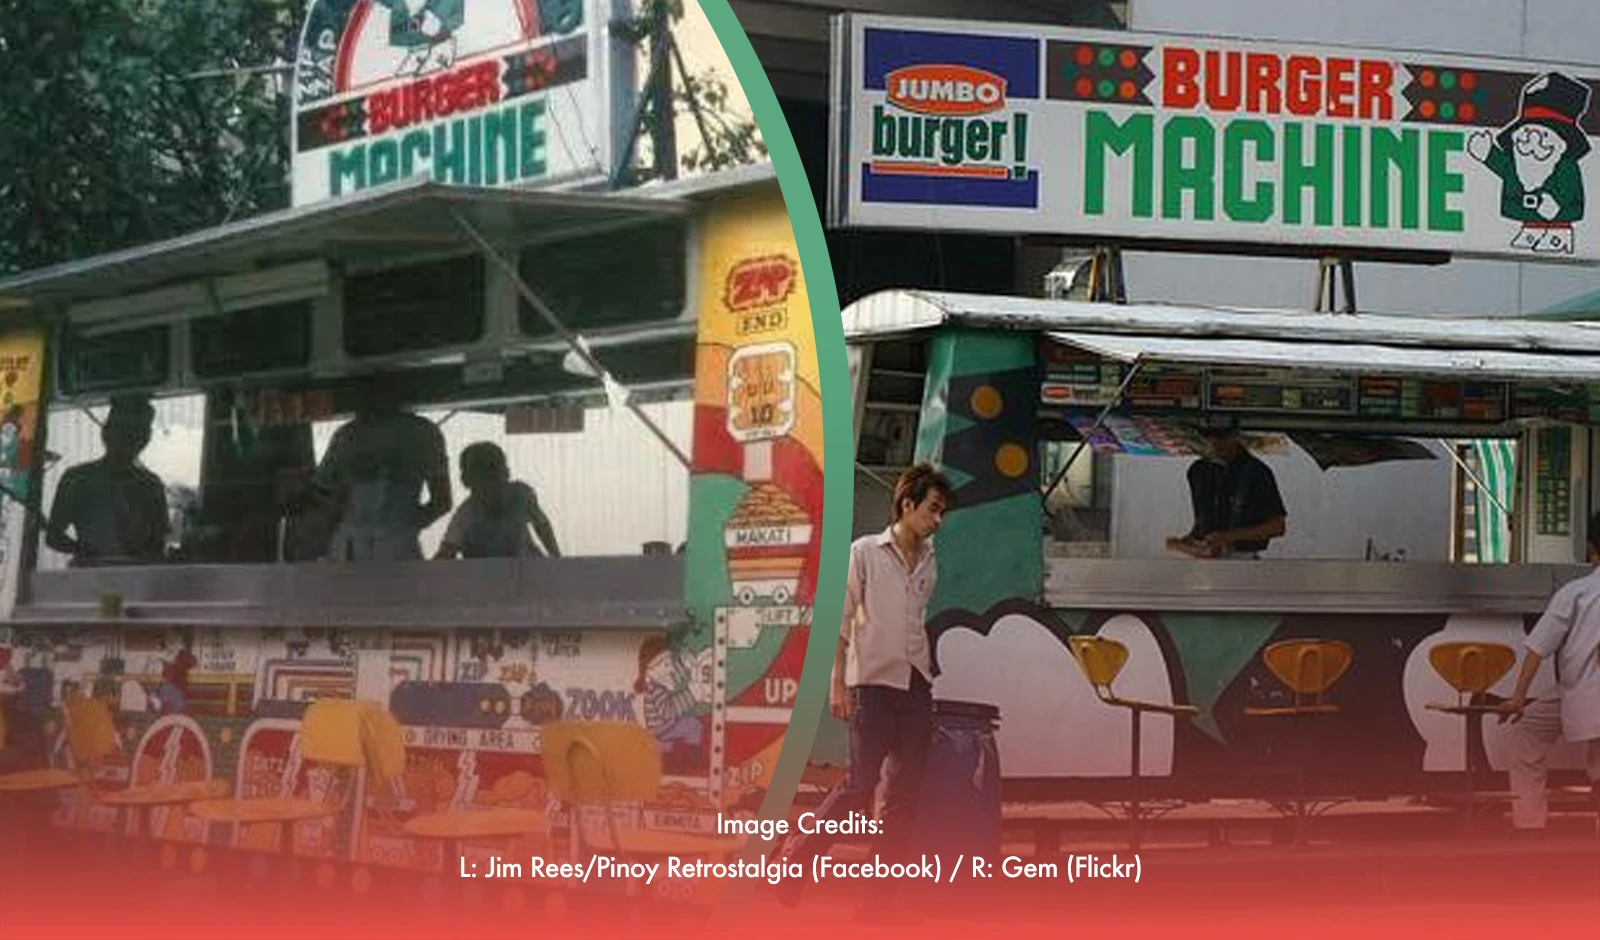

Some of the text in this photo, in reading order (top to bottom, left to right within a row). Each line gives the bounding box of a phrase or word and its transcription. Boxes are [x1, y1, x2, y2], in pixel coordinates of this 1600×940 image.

[365, 60, 501, 136] BURGER
[896, 79, 1001, 104] JUMBO
[1162, 46, 1394, 120] BURGER
[329, 96, 547, 198] MACHINE
[872, 105, 1028, 179] burger!
[1084, 110, 1465, 232] MACHINE
[736, 527, 792, 544] MAKATI
[764, 678, 798, 703] UP
[423, 729, 515, 749] DRYING AREA
